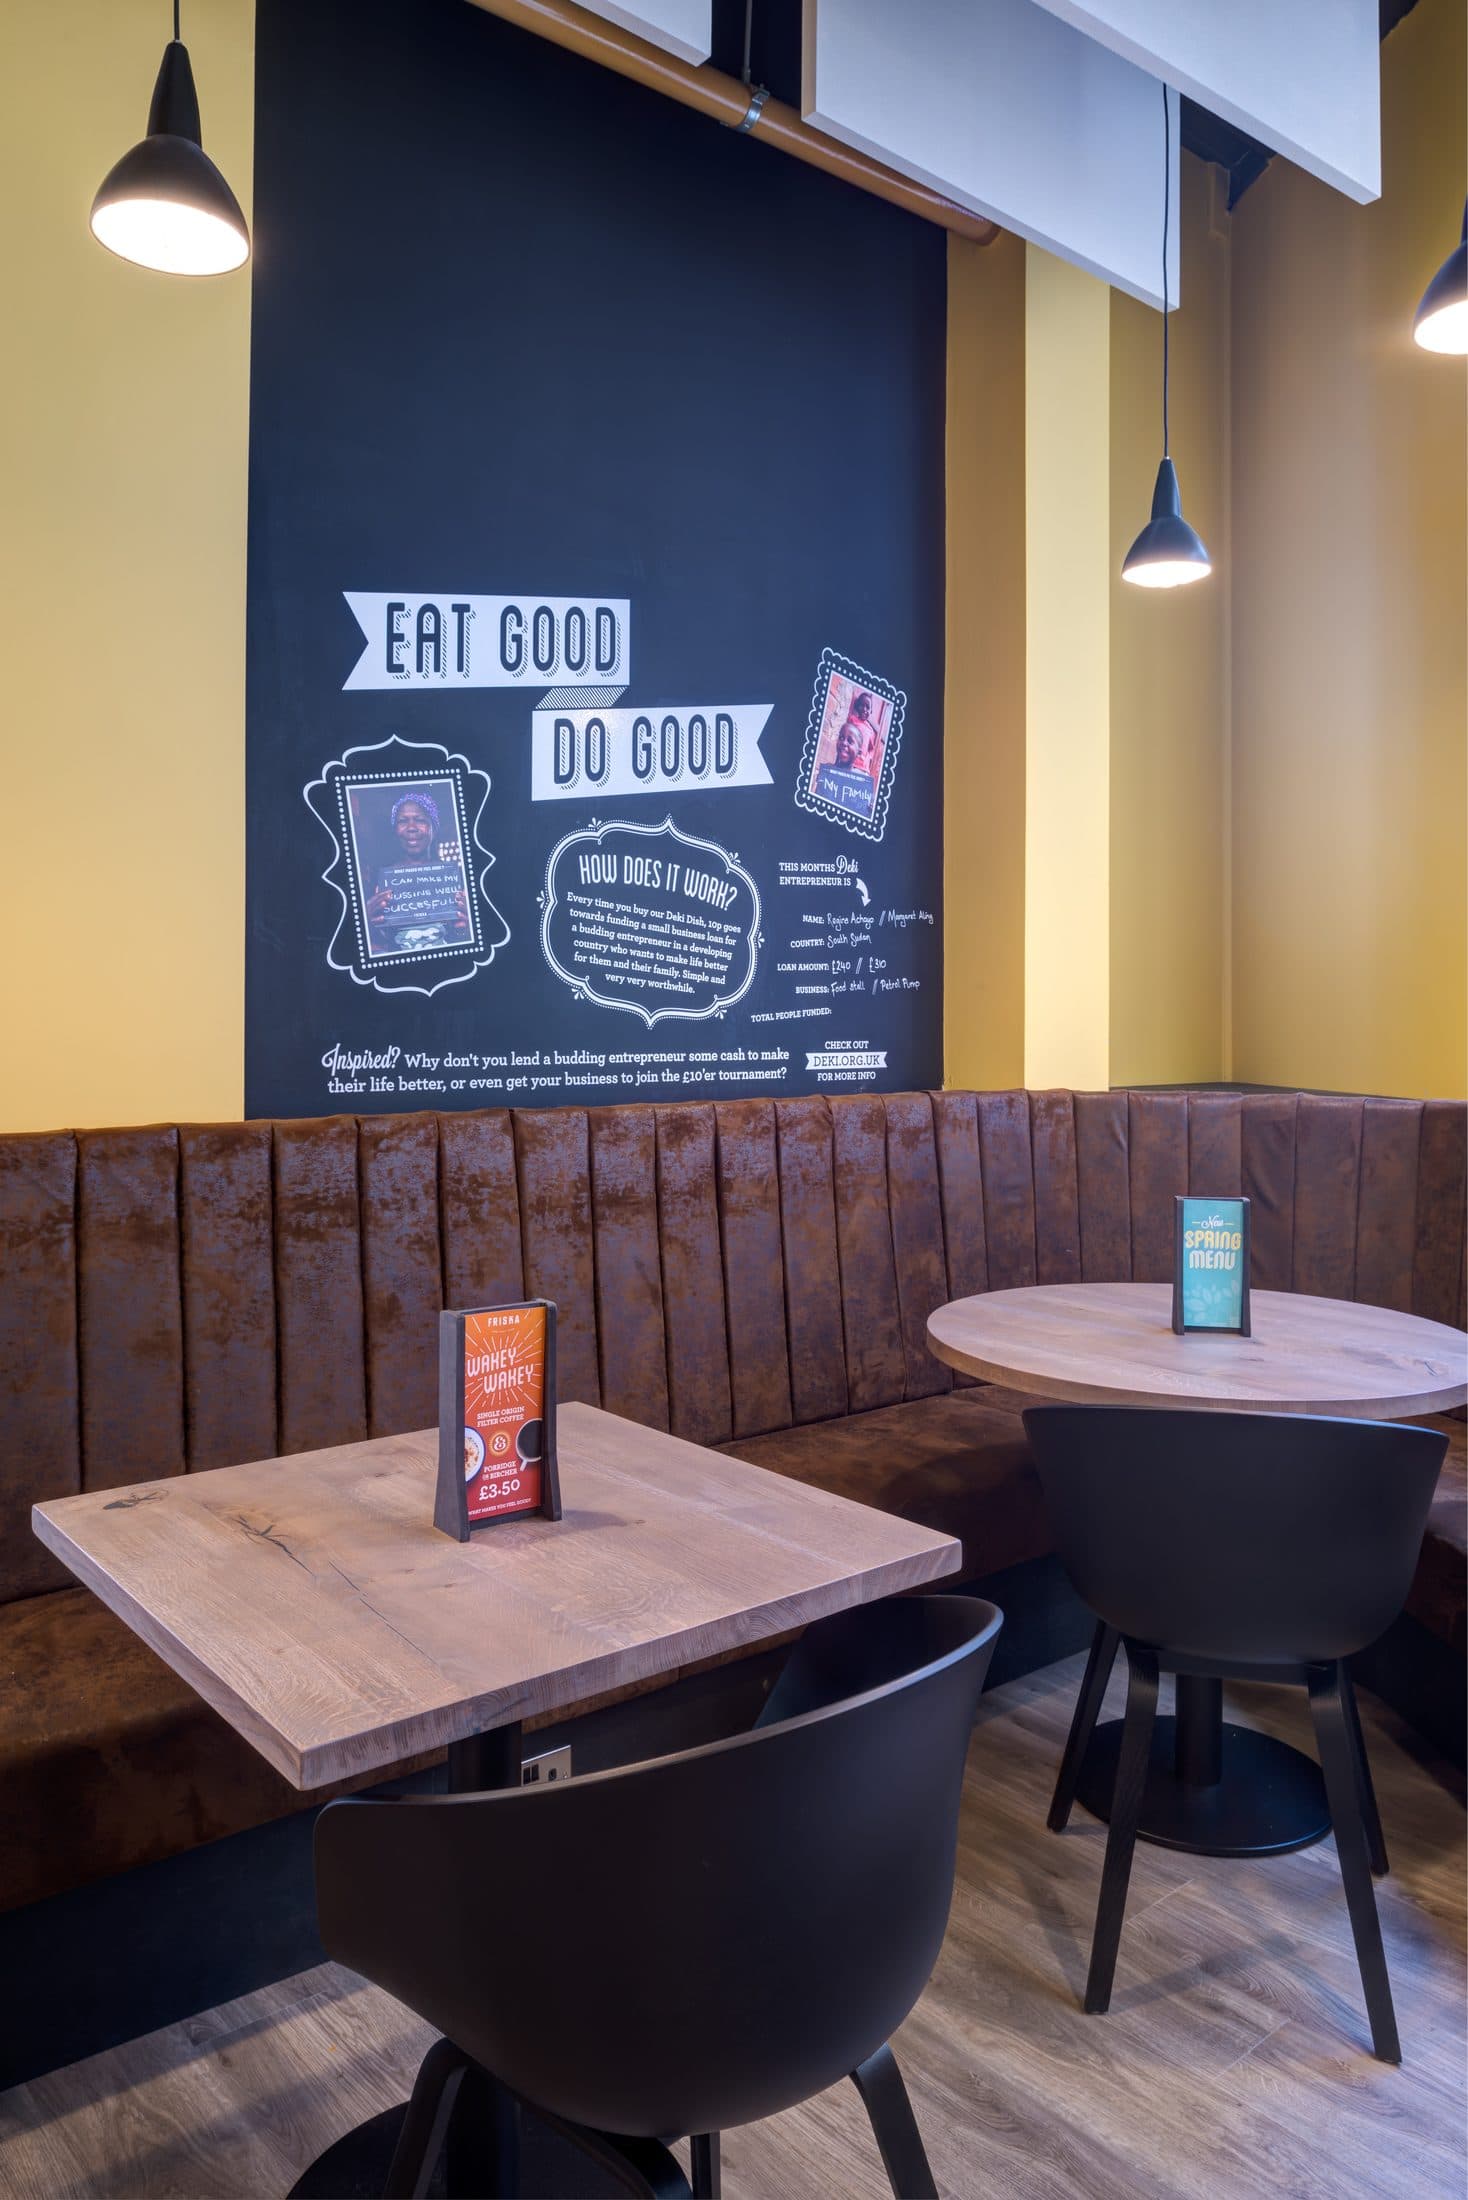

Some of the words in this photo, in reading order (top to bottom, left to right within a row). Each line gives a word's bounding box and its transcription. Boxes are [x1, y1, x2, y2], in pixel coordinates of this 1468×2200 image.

[386, 602, 476, 680] EAT
[500, 604, 621, 678] GOOD
[554, 717, 612, 790] DO
[632, 712, 738, 784] GOOD
[778, 862, 799, 872] THIS
[800, 863, 836, 873] MONTHS
[836, 855, 859, 875] Deki
[579, 854, 617, 885] HOW
[624, 855, 662, 888] DOES
[666, 863, 680, 892] IT
[684, 868, 737, 911] WORK?
[779, 876, 842, 886] ENTREPRENEUR
[843, 877, 852, 886] IS
[567, 891, 594, 907] Every
[595, 897, 614, 909] time
[616, 903, 632, 912] you
[633, 904, 650, 917] buy
[650, 910, 665, 919] our
[666, 911, 685, 923] Deki
[686, 914, 706, 928] Dish,
[708, 920, 722, 931] 10p
[723, 924, 741, 933] goes
[802, 914, 825, 924] NAME:
[569, 908, 605, 922] towards
[606, 913, 640, 930] funding
[641, 922, 646, 930] a
[648, 923, 670, 934] small
[671, 924, 706, 940] business
[707, 931, 724, 944] loan
[725, 935, 737, 946] for
[571, 924, 577, 932] a
[579, 922, 615, 940] budding
[616, 932, 672, 948] entrepreneur
[673, 940, 682, 950] in
[689, 942, 733, 960] developing
[790, 938, 825, 948] COUNTRY:
[827, 933, 848, 949] South
[573, 939, 608, 954] country
[610, 943, 628, 955] who
[629, 949, 654, 959] wants
[656, 952, 664, 961] to
[665, 954, 688, 965] make
[689, 956, 703, 968] life
[704, 958, 729, 972] better
[574, 951, 587, 963] for
[589, 954, 611, 967] them
[613, 959, 630, 969] and
[631, 960, 652, 973] their
[653, 964, 680, 979] family.
[682, 969, 710, 983] Simple
[710, 975, 726, 985] and
[777, 963, 797, 971] LOAN
[797, 963, 830, 971] AMOUNT:
[832, 959, 851, 975] £240
[605, 973, 626, 985] very
[626, 976, 647, 988] very
[647, 980, 696, 994] worthwhile.
[795, 986, 830, 994] BUSINESS:
[750, 1013, 775, 1022] TOTAL
[775, 1010, 802, 1020] PEOPLE
[802, 1007, 832, 1017] FUNDED:
[824, 1040, 852, 1049] CHECK
[852, 1040, 869, 1049] OUT
[321, 1043, 401, 1078] Inspired?
[404, 1052, 440, 1071] Why
[443, 1052, 479, 1068] don't
[482, 1055, 508, 1070] you
[511, 1051, 540, 1066] lend
[543, 1055, 551, 1066] a
[554, 1050, 605, 1067] budding
[608, 1052, 686, 1066] entrepreneur
[688, 1051, 718, 1062] some
[720, 1048, 746, 1061] cash
[748, 1049, 759, 1061] to
[761, 1047, 790, 1060] make
[813, 1054, 881, 1067] DEKI.ORG.UK
[327, 1076, 366, 1093] their
[370, 1076, 395, 1092] life
[398, 1076, 447, 1093] better,
[450, 1079, 466, 1090] or
[469, 1078, 503, 1089] even
[506, 1075, 528, 1090] get
[530, 1076, 562, 1090] your
[564, 1071, 618, 1086] business
[621, 1072, 633, 1084] to
[635, 1070, 659, 1086] join
[661, 1068, 680, 1083] the
[682, 1068, 716, 1084] £10'er
[718, 1067, 788, 1080] tournament?
[817, 1072, 833, 1081] FOR
[834, 1071, 857, 1081] MORE
[858, 1071, 876, 1080] INFO
[1184, 1230, 1242, 1251] SPRING
[1189, 1249, 1236, 1270] MENU
[487, 1314, 520, 1327] FRISKA
[467, 1346, 517, 1378] WAKEY
[483, 1363, 534, 1394] WAKEY
[477, 1410, 500, 1420] SINGLE
[501, 1406, 525, 1415] ORIGIN
[477, 1418, 499, 1428] FILTER
[499, 1414, 525, 1423] COFFEE
[484, 1460, 517, 1473] PORRIDGE
